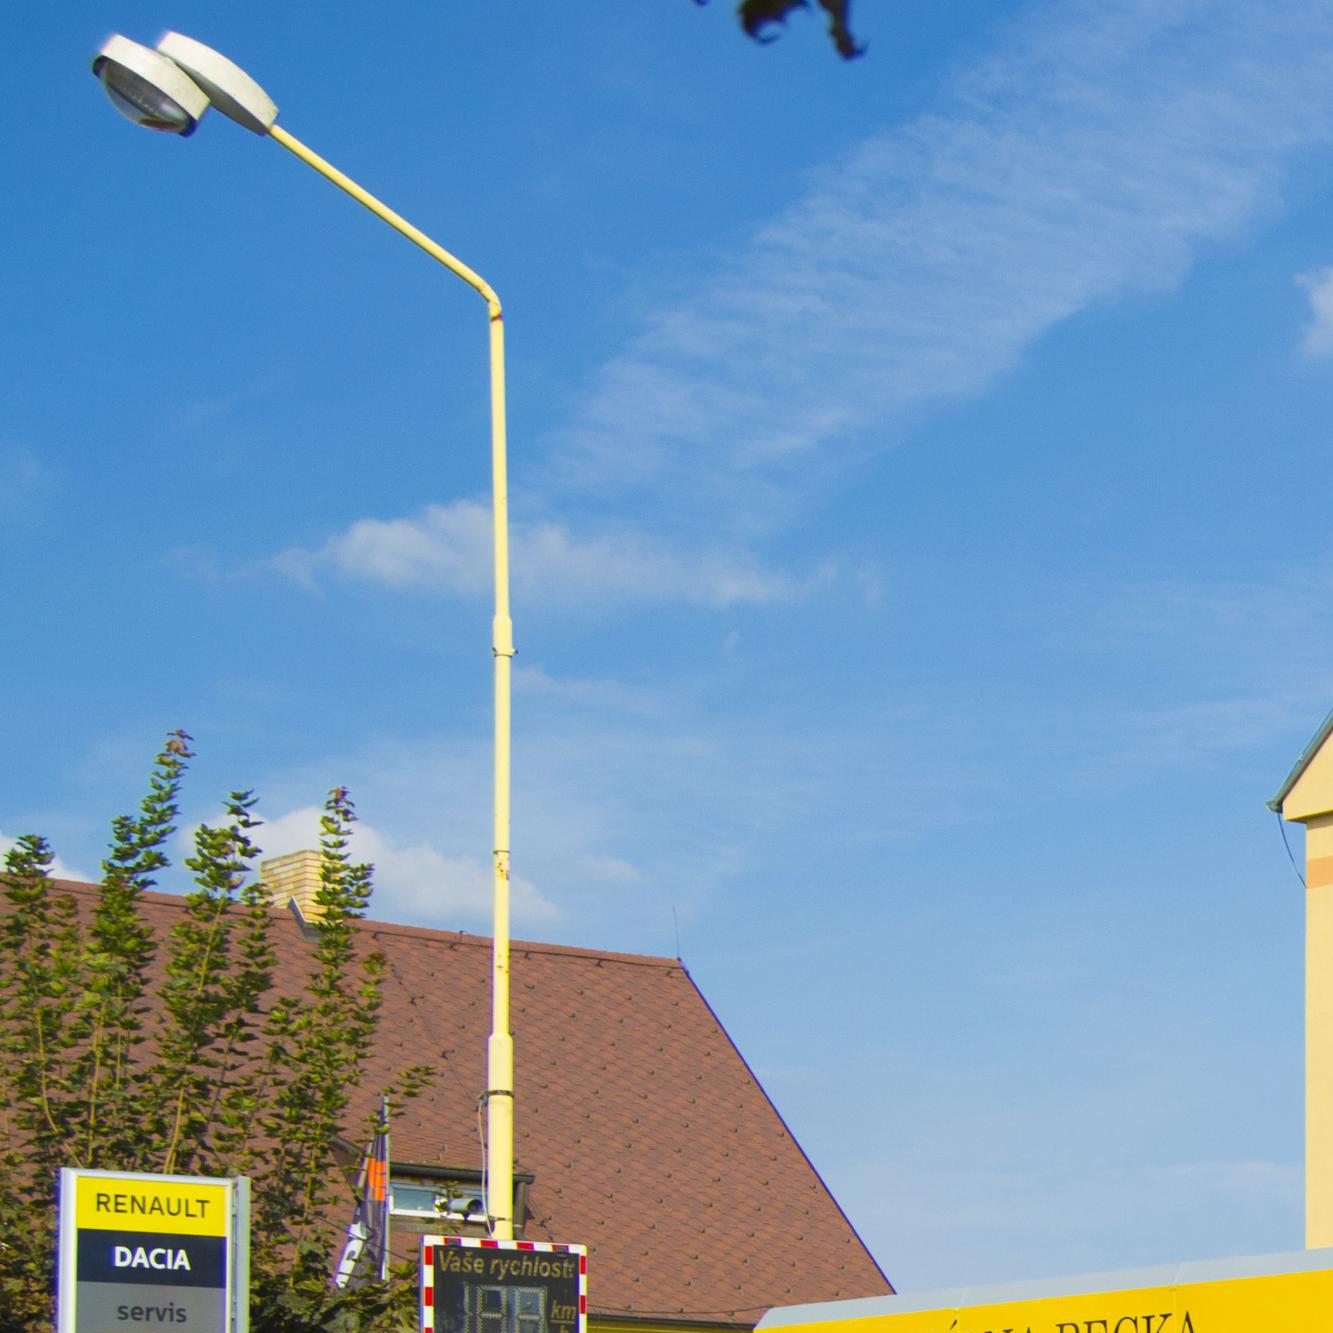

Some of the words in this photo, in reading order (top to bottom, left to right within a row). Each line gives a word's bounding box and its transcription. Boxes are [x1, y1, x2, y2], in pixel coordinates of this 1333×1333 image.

[96, 1193, 210, 1218] RENAULT
[114, 1246, 192, 1271] DACIA
[439, 1250, 485, 1274] Vaše
[117, 1302, 187, 1323] servis
[550, 1300, 577, 1320] km
